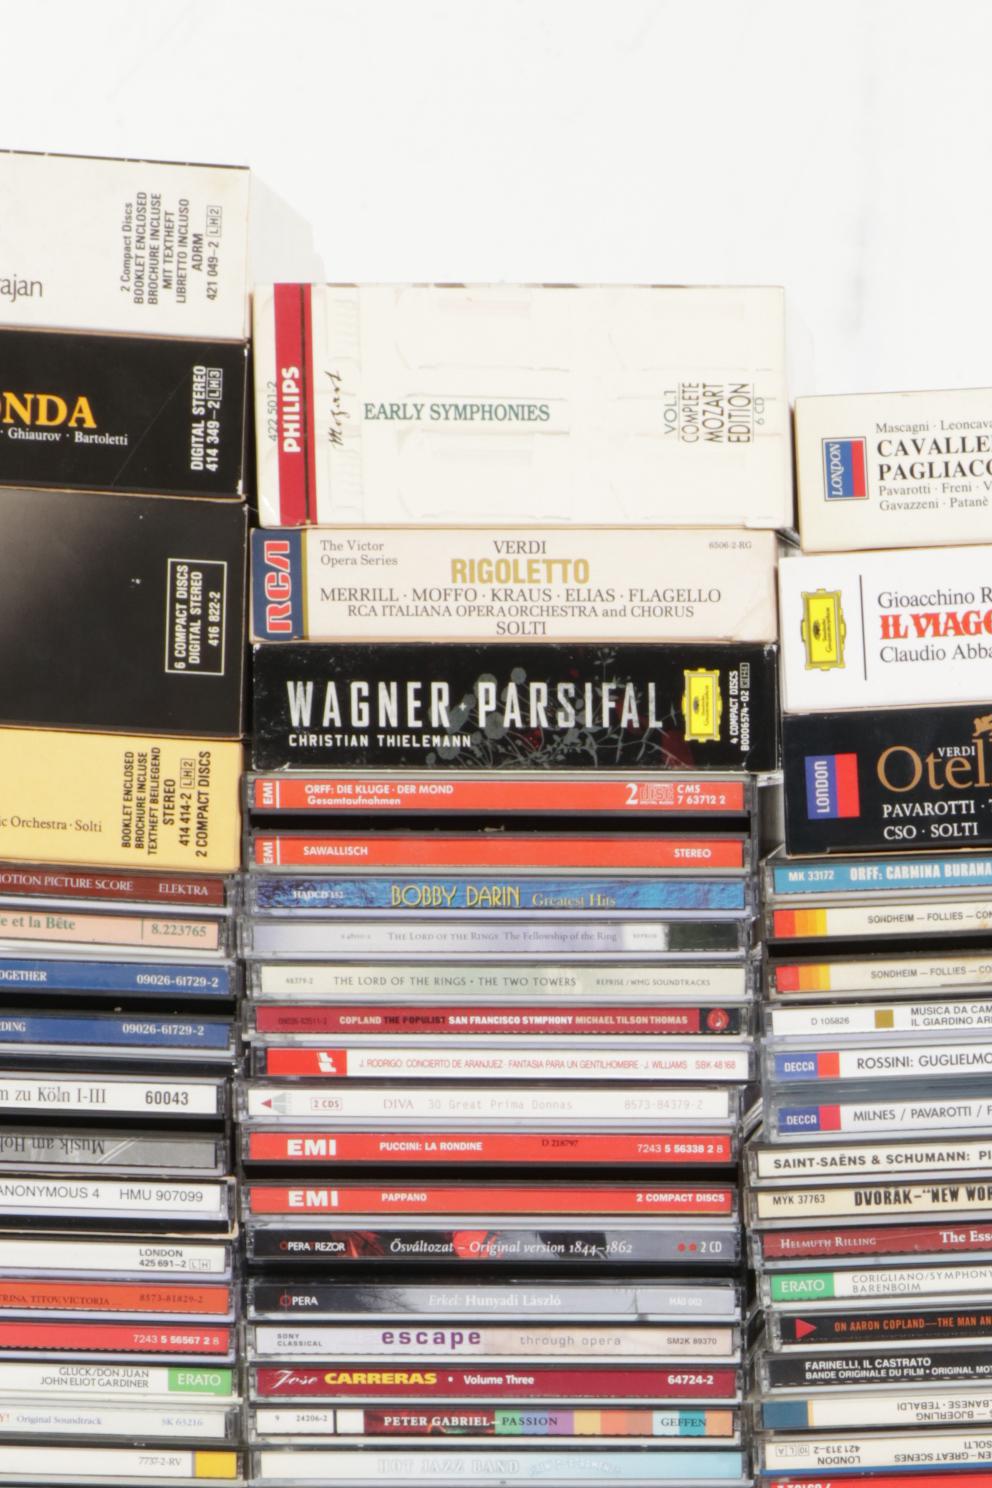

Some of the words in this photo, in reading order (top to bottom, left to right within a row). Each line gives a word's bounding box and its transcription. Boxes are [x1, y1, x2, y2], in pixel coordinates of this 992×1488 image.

[136, 191, 148, 251] ENCLOSED
[134, 253, 145, 304] BOOKLET
[192, 366, 207, 415] STEREO
[282, 366, 301, 452] PHILIPS
[363, 403, 425, 422] EARLY
[429, 404, 551, 422] SYMPHONIES
[681, 382, 700, 443] COMPLETE
[703, 383, 724, 443] MOZART
[728, 383, 751, 443] EDITION
[8, 427, 61, 442] Ghiaurov
[74, 431, 129, 446] Bartoletti
[191, 419, 205, 471] DIGITAL
[493, 541, 546, 554] VERDI
[451, 559, 589, 584] RIGOLETTO
[265, 540, 292, 633] RCA
[320, 588, 399, 602] MERRILL
[411, 589, 478, 602] MOFFO
[628, 589, 722, 603] FLAGELLO
[877, 588, 976, 610] Gioacchino
[880, 614, 909, 639] IL
[879, 644, 948, 663] Claudio
[286, 681, 450, 728] WAGNER
[479, 681, 663, 729] PARSIFAL
[289, 735, 368, 747] CHRISTIAN
[378, 735, 471, 748] THIELEMANN
[882, 800, 976, 818] PAVAROTTI
[303, 846, 368, 857] SAWALLISCH
[159, 883, 208, 896] ELEKTRA
[390, 885, 458, 906] BOBBY
[467, 886, 520, 905] DARIN
[151, 923, 207, 937] 8.223765
[137, 975, 219, 988] 09026-61729-2
[449, 1015, 467, 1024] SAN
[469, 1015, 520, 1024] FRANCISCO
[522, 1016, 573, 1025] SYMPHONY
[856, 1055, 914, 1070] ROSSINI:
[145, 1091, 189, 1105] 60043
[911, 1105, 973, 1119] PAVAROTTI
[287, 1139, 337, 1155] EMI
[380, 1141, 422, 1151] PUCCINI:
[439, 1141, 483, 1151] RONDINE
[119, 1189, 151, 1201] HMU
[156, 1190, 204, 1202] 907099
[381, 1192, 427, 1202] PAPPANO
[939, 1230, 964, 1244] The
[780, 1278, 825, 1293] ERATO
[381, 1329, 482, 1349] escape
[177, 1373, 221, 1386] ERATO
[324, 1373, 437, 1384] CARRERAS
[502, 1417, 558, 1426] PASSION
[661, 1417, 706, 1427] GEFFEN
